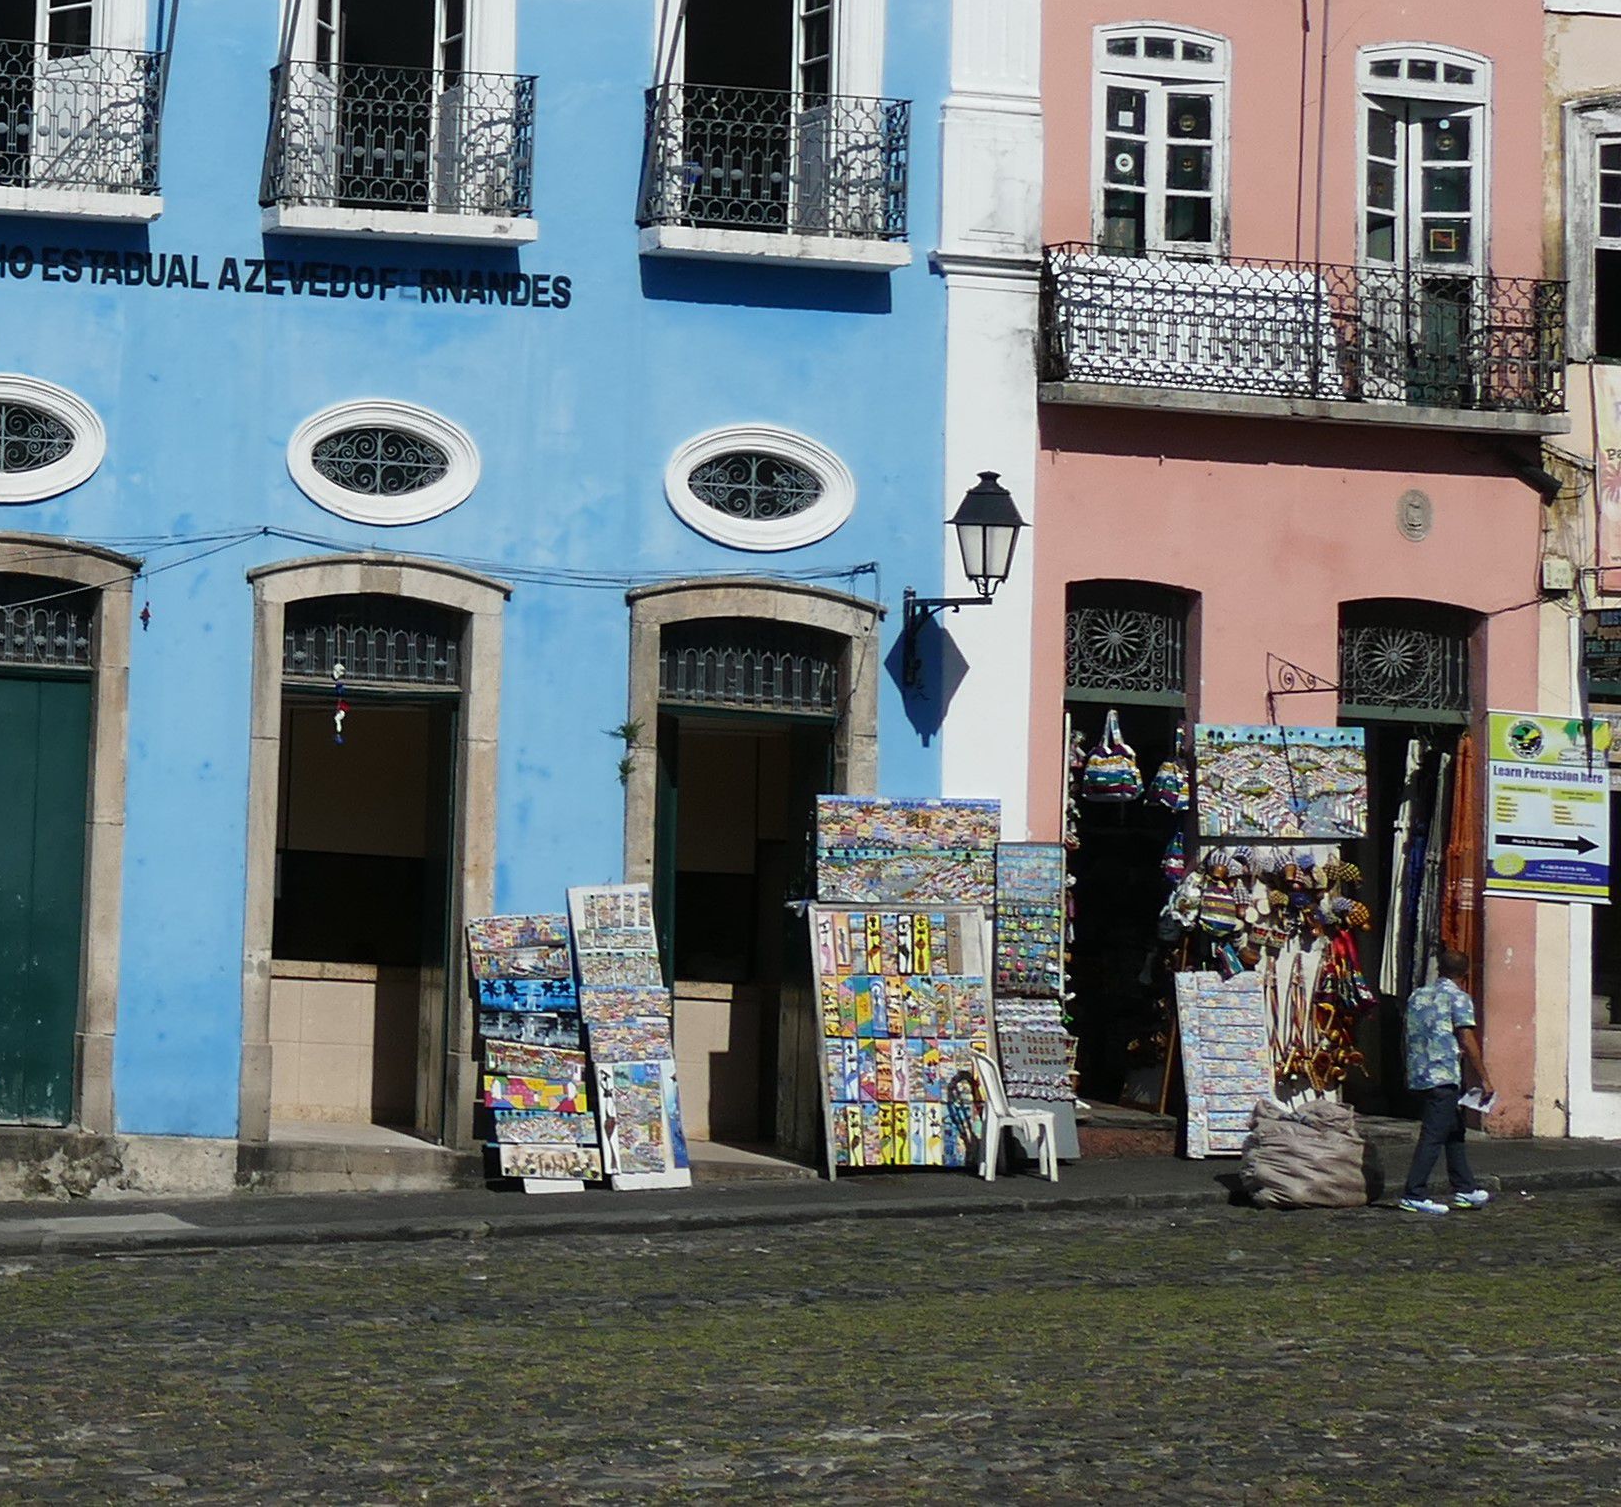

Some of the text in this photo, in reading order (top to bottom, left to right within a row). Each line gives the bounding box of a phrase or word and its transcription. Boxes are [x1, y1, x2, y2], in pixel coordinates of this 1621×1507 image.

[42, 247, 210, 290] ESTADUAL
[218, 256, 374, 300] AZEVEDO
[1493, 765, 1522, 778] Learn
[1524, 767, 1579, 782] Percussion
[1580, 771, 1604, 784] here
